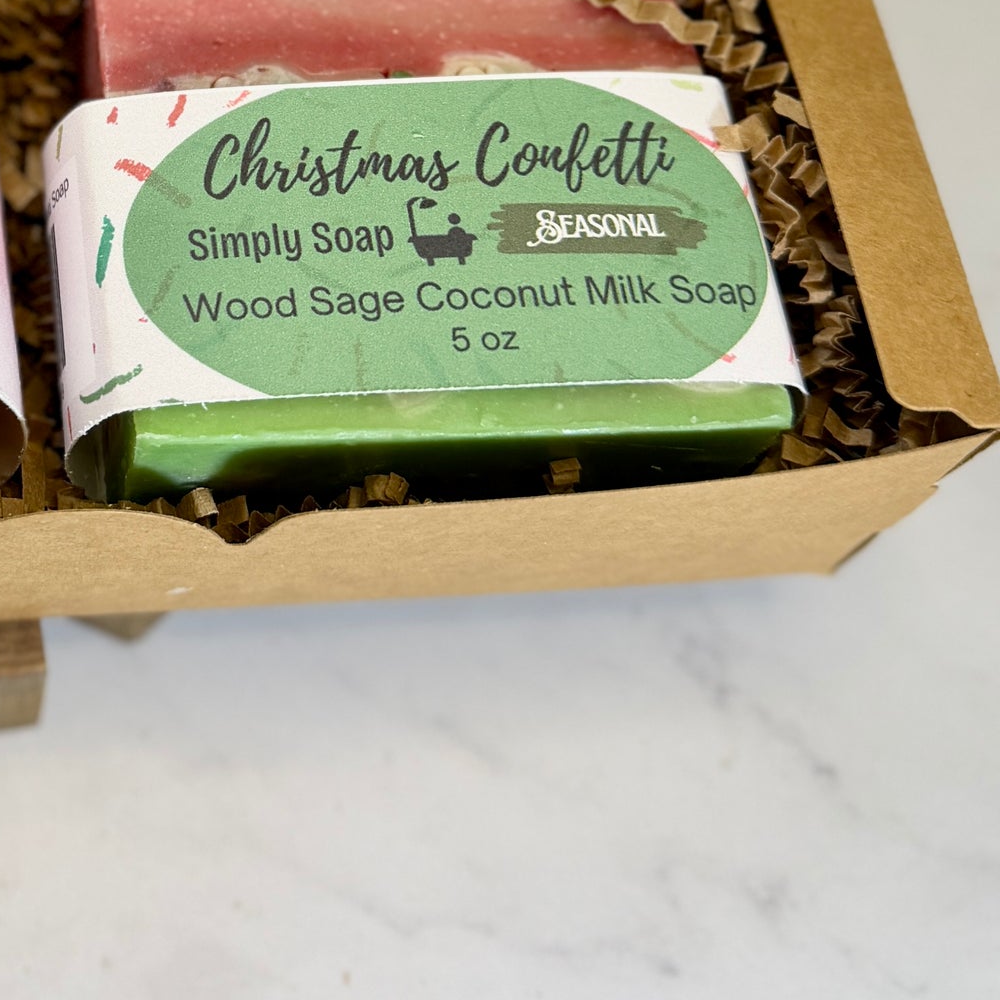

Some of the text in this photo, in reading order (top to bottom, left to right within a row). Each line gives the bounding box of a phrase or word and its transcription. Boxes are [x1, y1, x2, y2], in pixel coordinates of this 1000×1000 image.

[203, 117, 676, 201] Christmas Confetti
[188, 221, 394, 264] Simply Soap
[182, 274, 757, 323] Wood Sage Coconut Milk Soap
[451, 326, 520, 353] 5 oz
